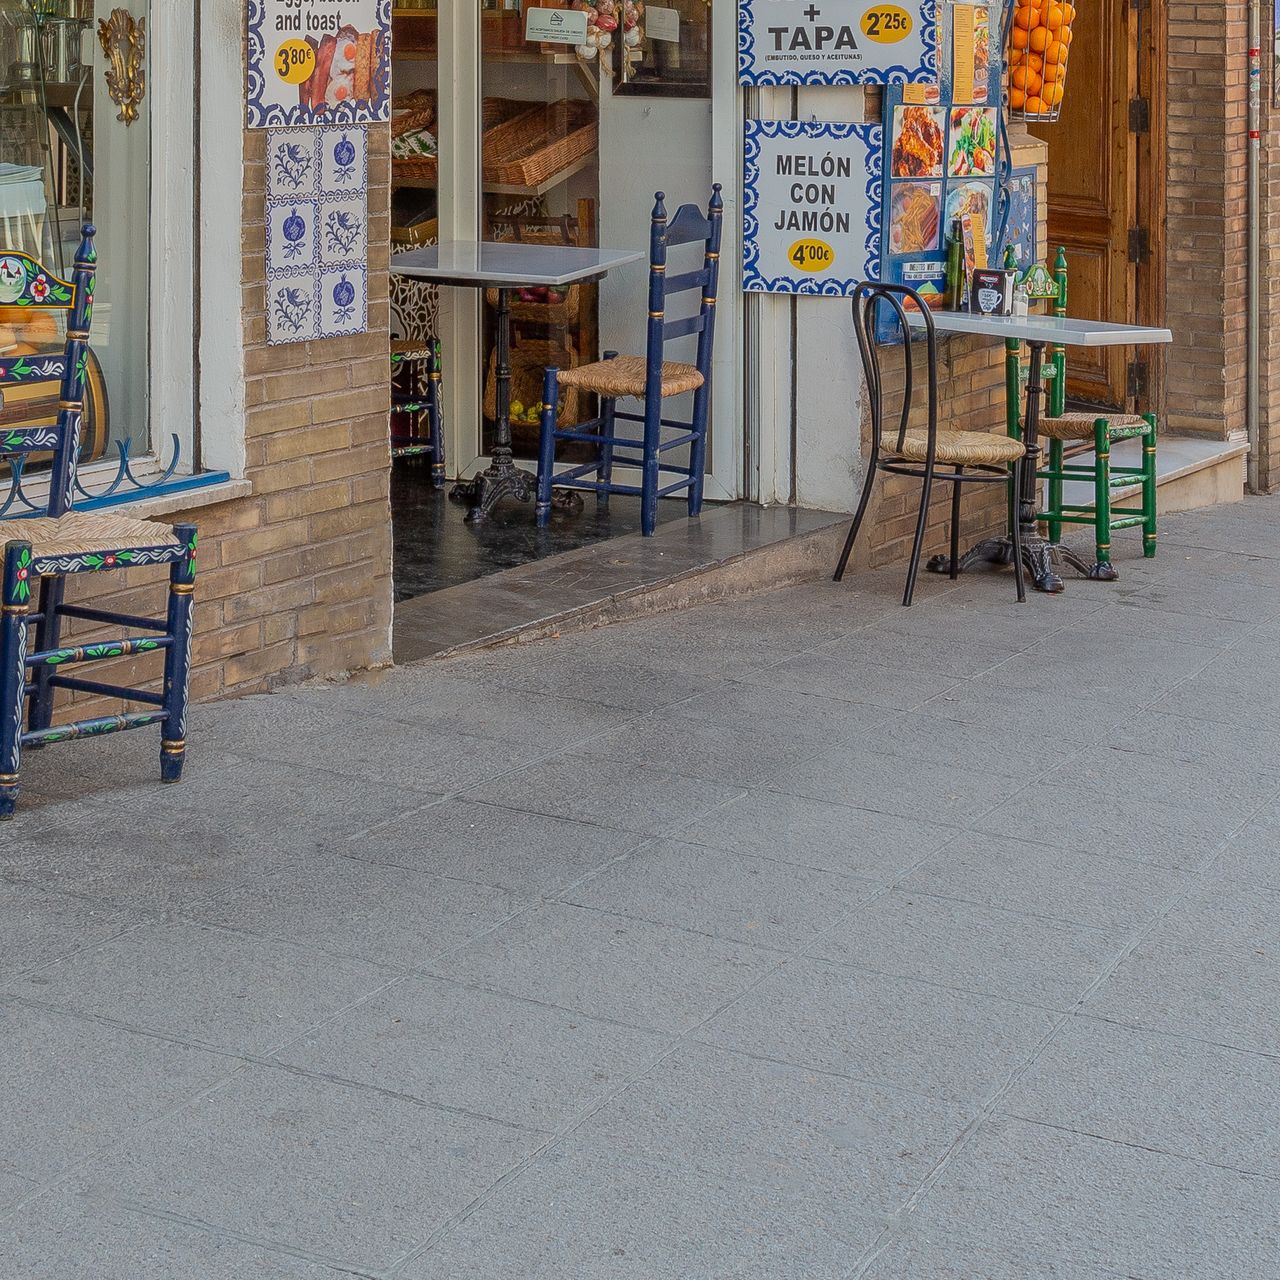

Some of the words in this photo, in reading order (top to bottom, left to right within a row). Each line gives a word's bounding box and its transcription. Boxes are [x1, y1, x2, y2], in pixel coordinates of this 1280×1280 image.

[276, 10, 301, 30] and
[306, 10, 341, 30] toast
[804, 5, 820, 22] +
[768, 25, 857, 51] TAPA
[800, 53, 820, 61] QUESO
[827, 53, 863, 61] ACEITUNAS)
[776, 152, 851, 177] MELÓN
[790, 183, 835, 204] CON
[774, 208, 850, 233] JAMÓN
